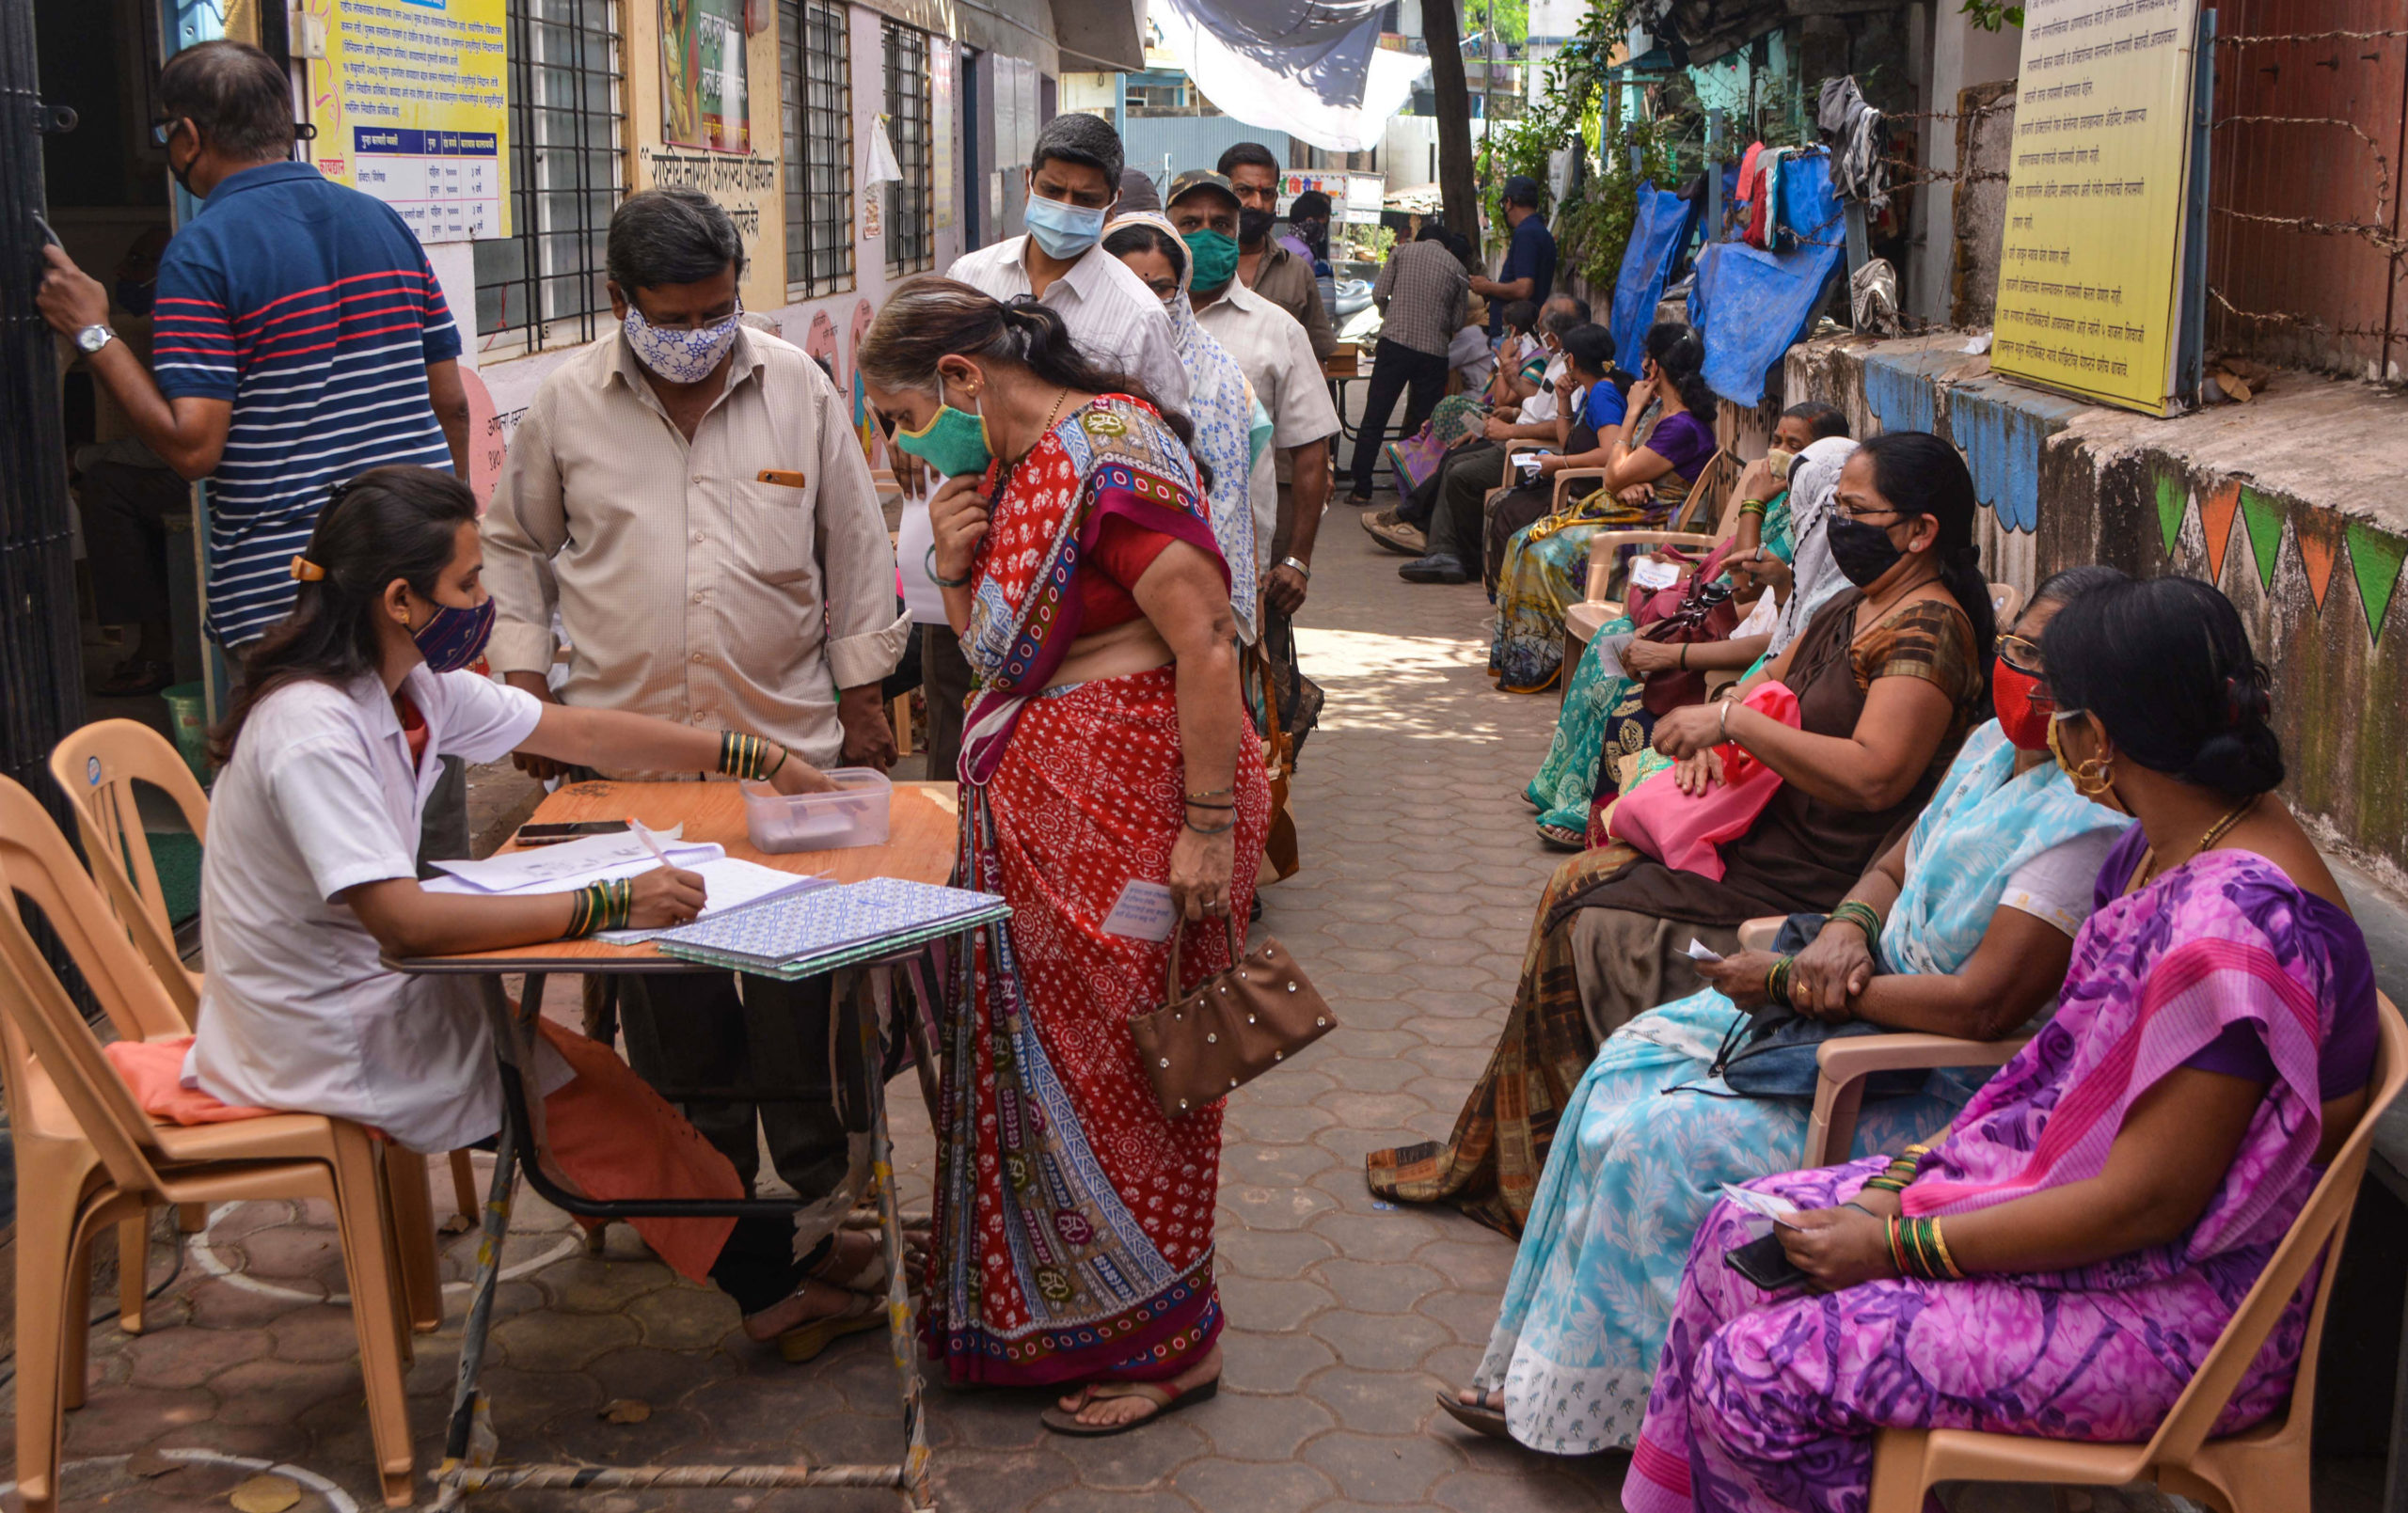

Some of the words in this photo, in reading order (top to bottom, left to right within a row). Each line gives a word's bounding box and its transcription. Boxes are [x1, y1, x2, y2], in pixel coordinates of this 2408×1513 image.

[485, 23, 501, 35] विकास
[319, 152, 345, 176] कायद्याने
[2125, 177, 2145, 196] तपासणी
[487, 412, 510, 436] आपला
